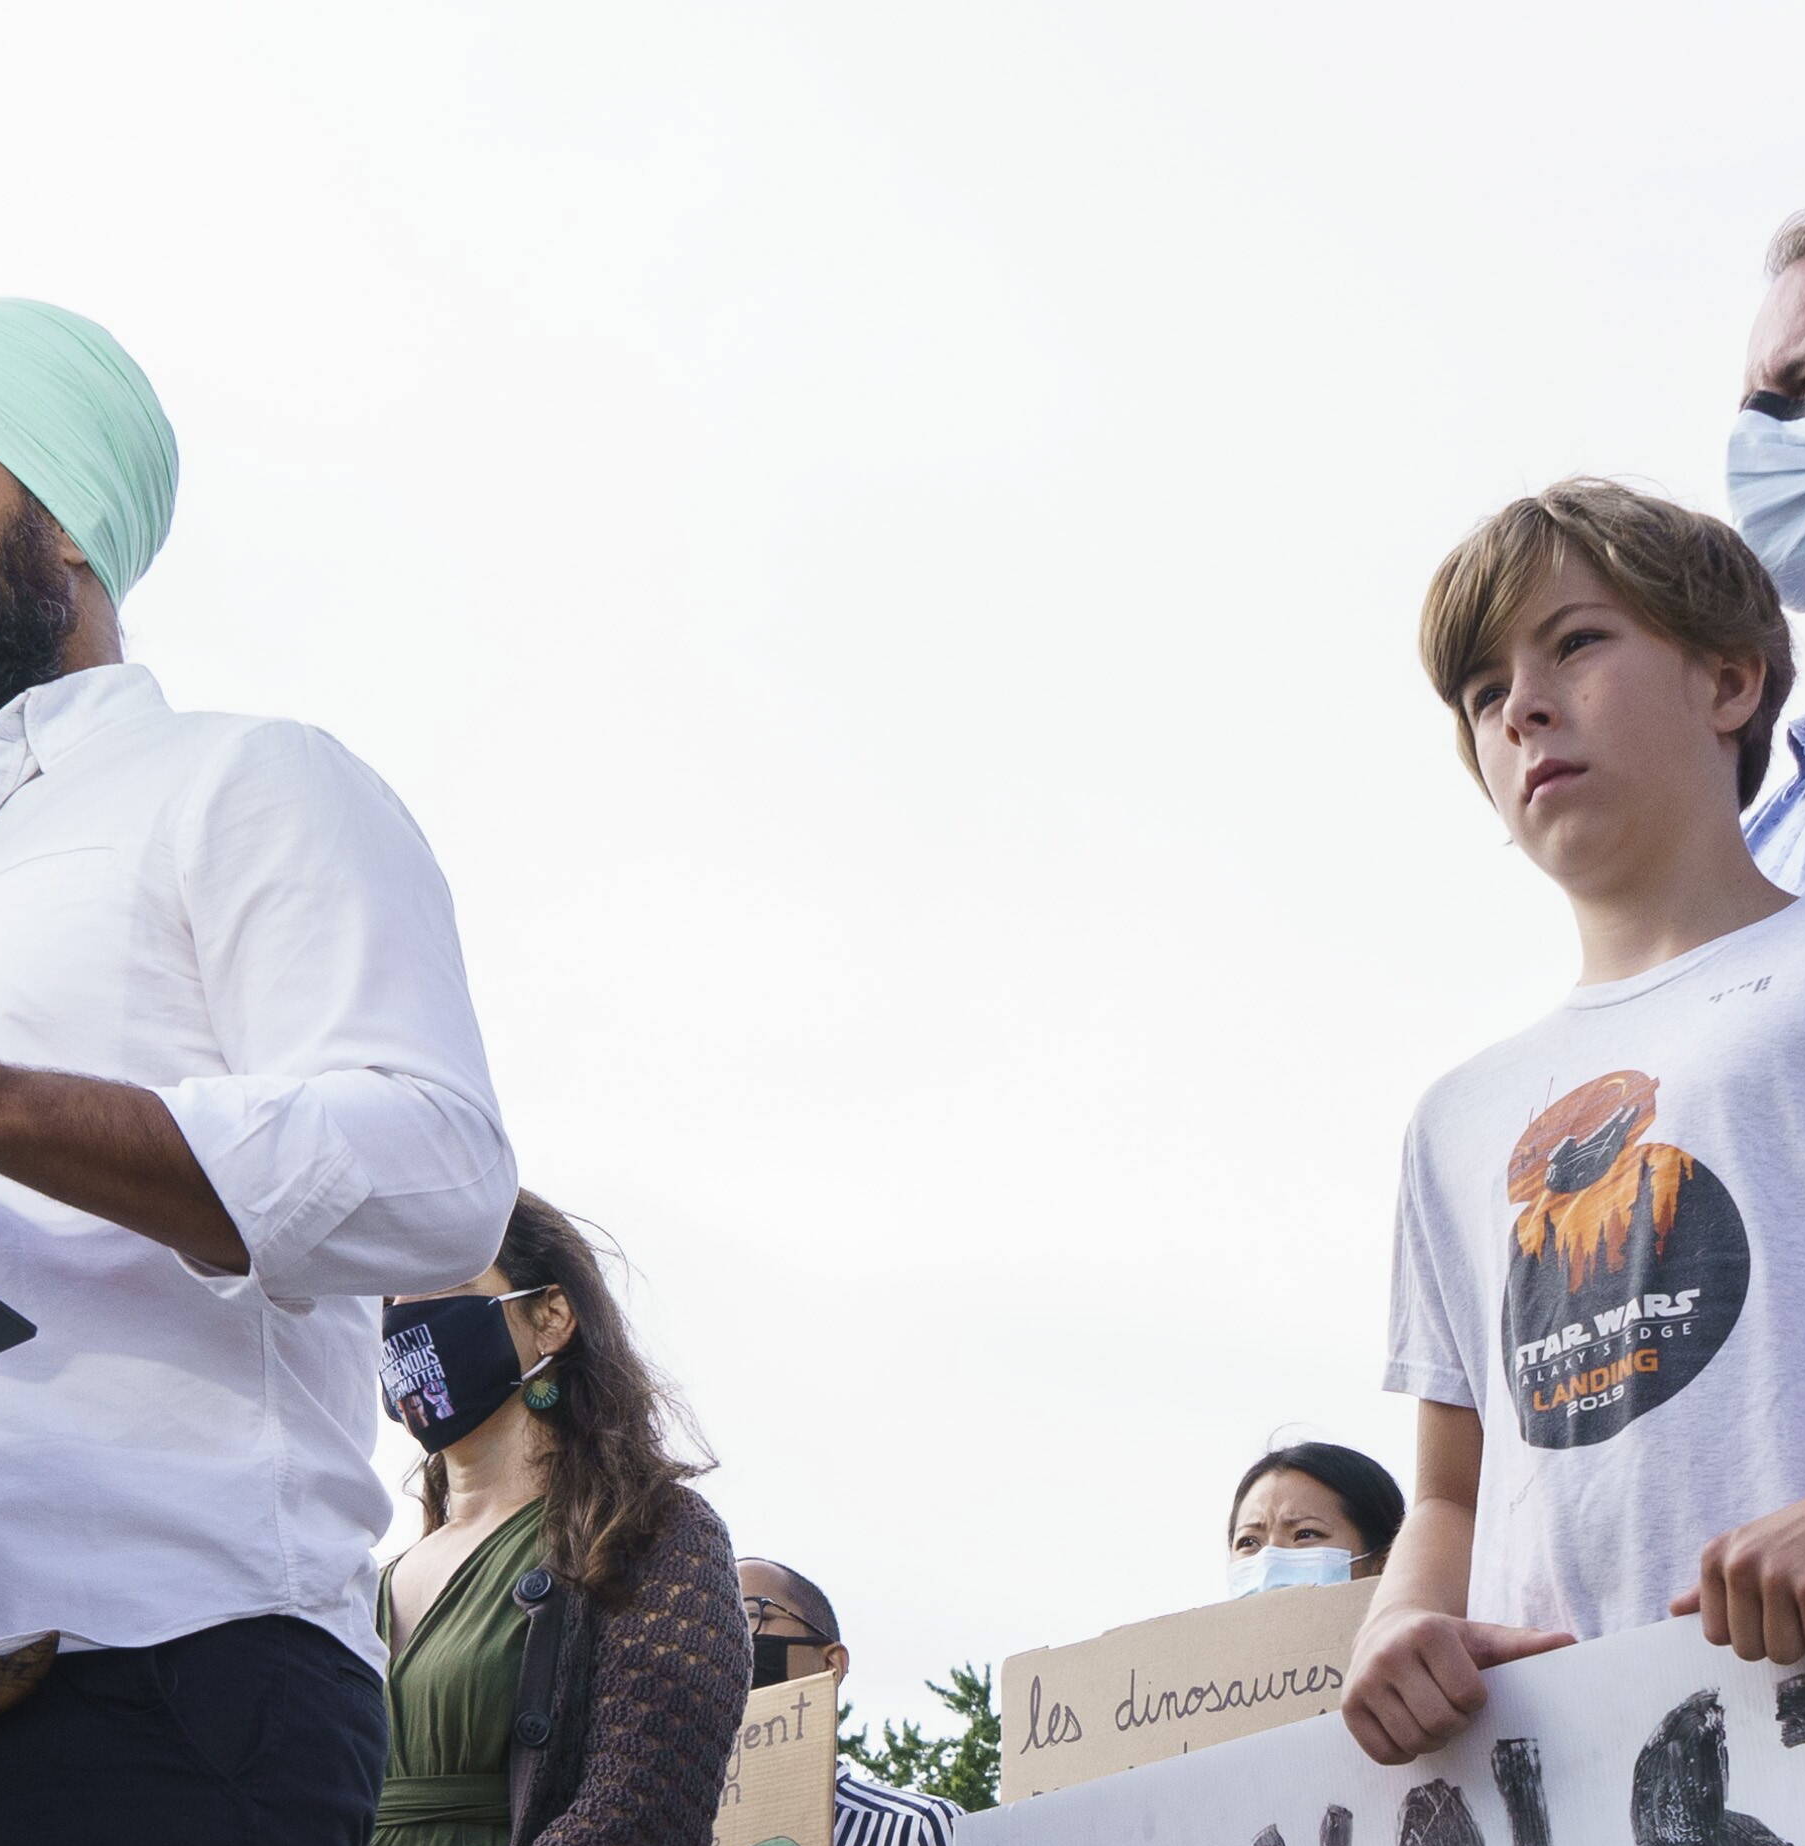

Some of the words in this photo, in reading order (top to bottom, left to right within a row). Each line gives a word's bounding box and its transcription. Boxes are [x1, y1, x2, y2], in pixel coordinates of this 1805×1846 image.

[1515, 1322, 1592, 1370] STAR
[1594, 1288, 1701, 1337] WARS
[1520, 1343, 1612, 1388] ALAXY'S
[1625, 1321, 1693, 1346] EDGE
[1532, 1348, 1659, 1412] LANDING
[1566, 1384, 1625, 1418] 2019
[726, 1691, 811, 1781] gent
[1020, 1675, 1082, 1755] les
[1115, 1668, 1343, 1731] dinosaures
